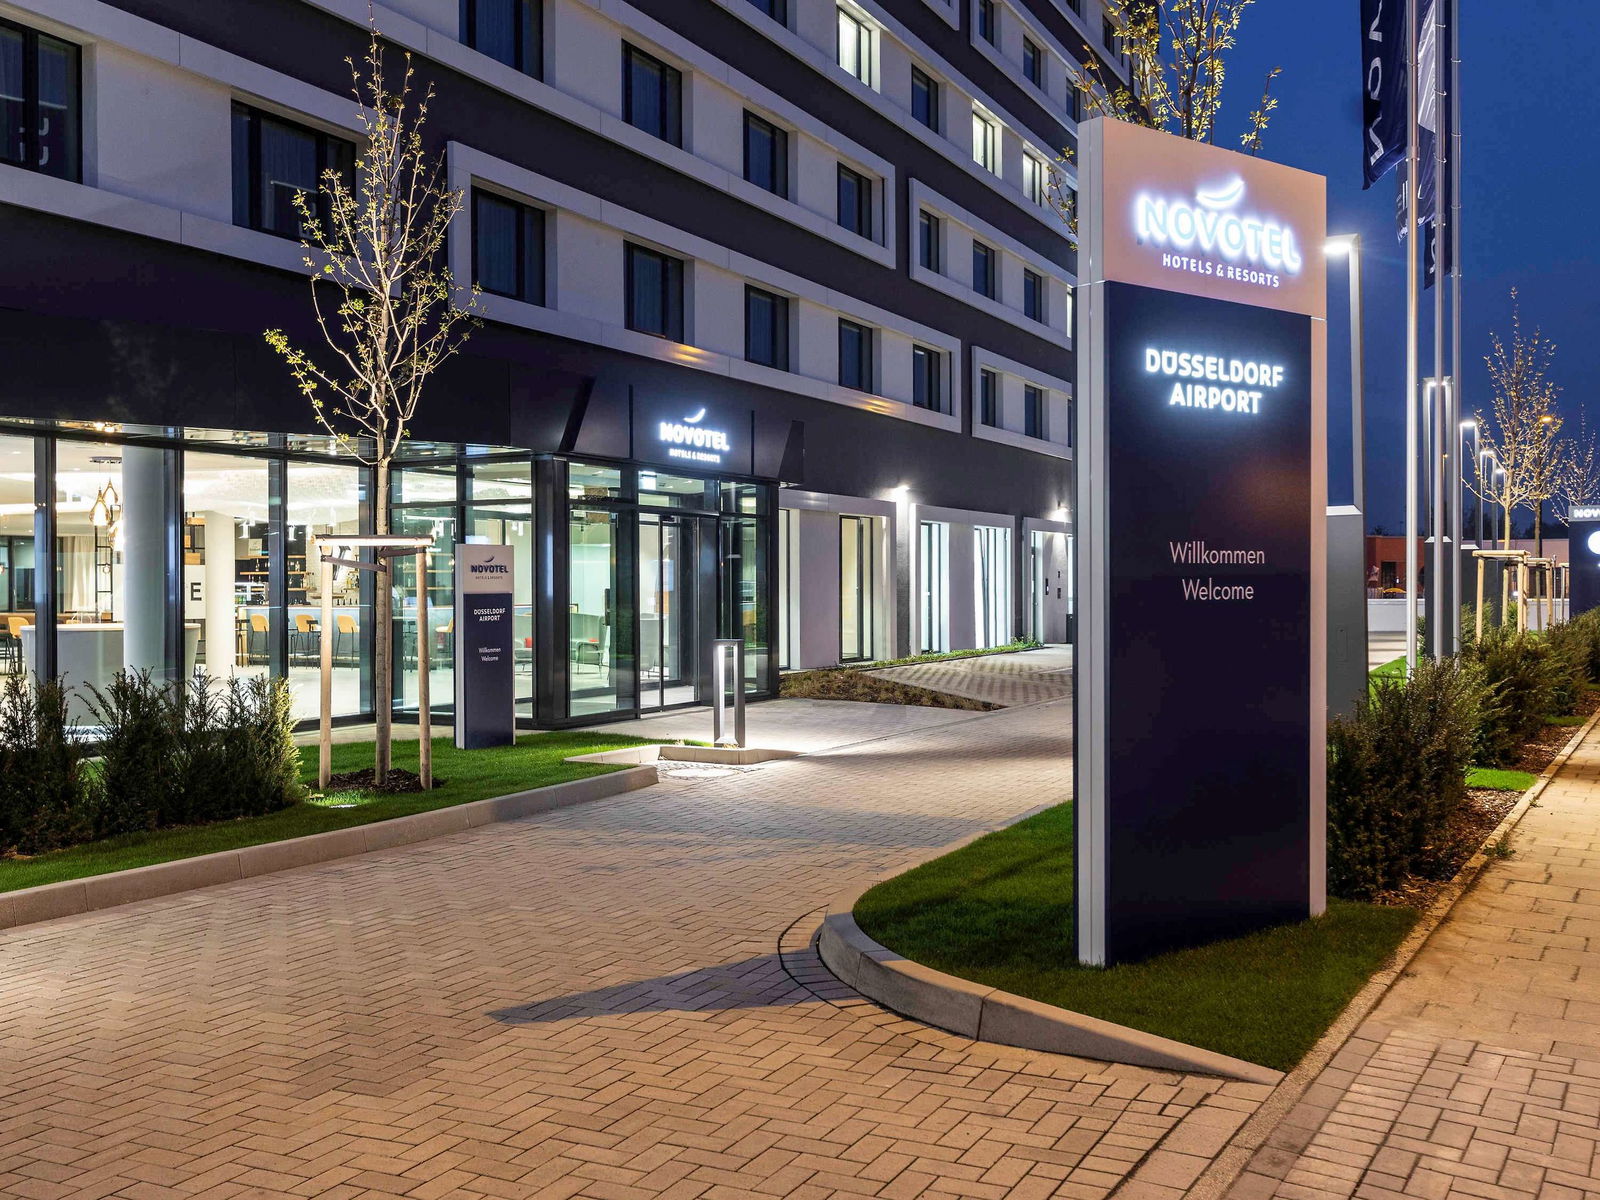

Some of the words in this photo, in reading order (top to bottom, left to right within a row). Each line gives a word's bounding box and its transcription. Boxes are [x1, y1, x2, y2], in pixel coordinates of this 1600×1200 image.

[1135, 194, 1302, 272] NOVOTEL
[1163, 253, 1213, 275] HOTELS
[1216, 264, 1225, 277] &
[1227, 266, 1280, 288] RESORTS
[1145, 348, 1284, 388] DÜSSELDORF
[1169, 382, 1263, 414] AIRPORT
[659, 421, 730, 451] NOVOTEL
[1169, 541, 1265, 564] Willkommen
[470, 564, 509, 573] NOVOTEL
[1182, 577, 1254, 601] Welcome
